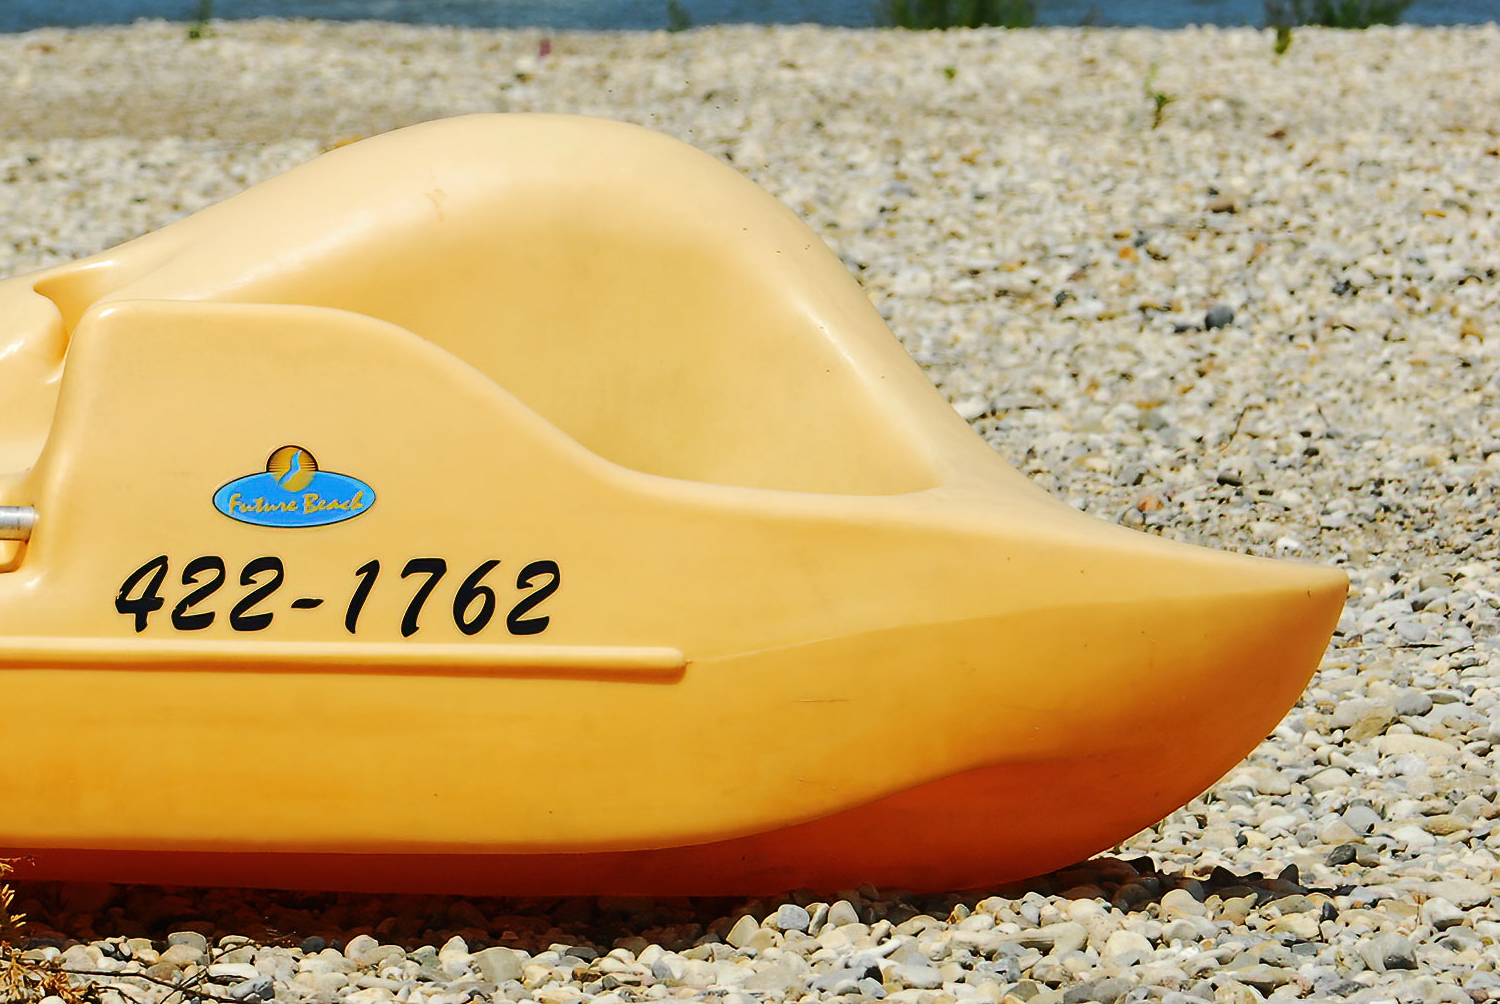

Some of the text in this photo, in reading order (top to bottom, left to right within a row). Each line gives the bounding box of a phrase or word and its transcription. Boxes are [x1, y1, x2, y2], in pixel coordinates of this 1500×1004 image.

[229, 491, 364, 514] Future Beach
[115, 555, 560, 637] 422-1762
